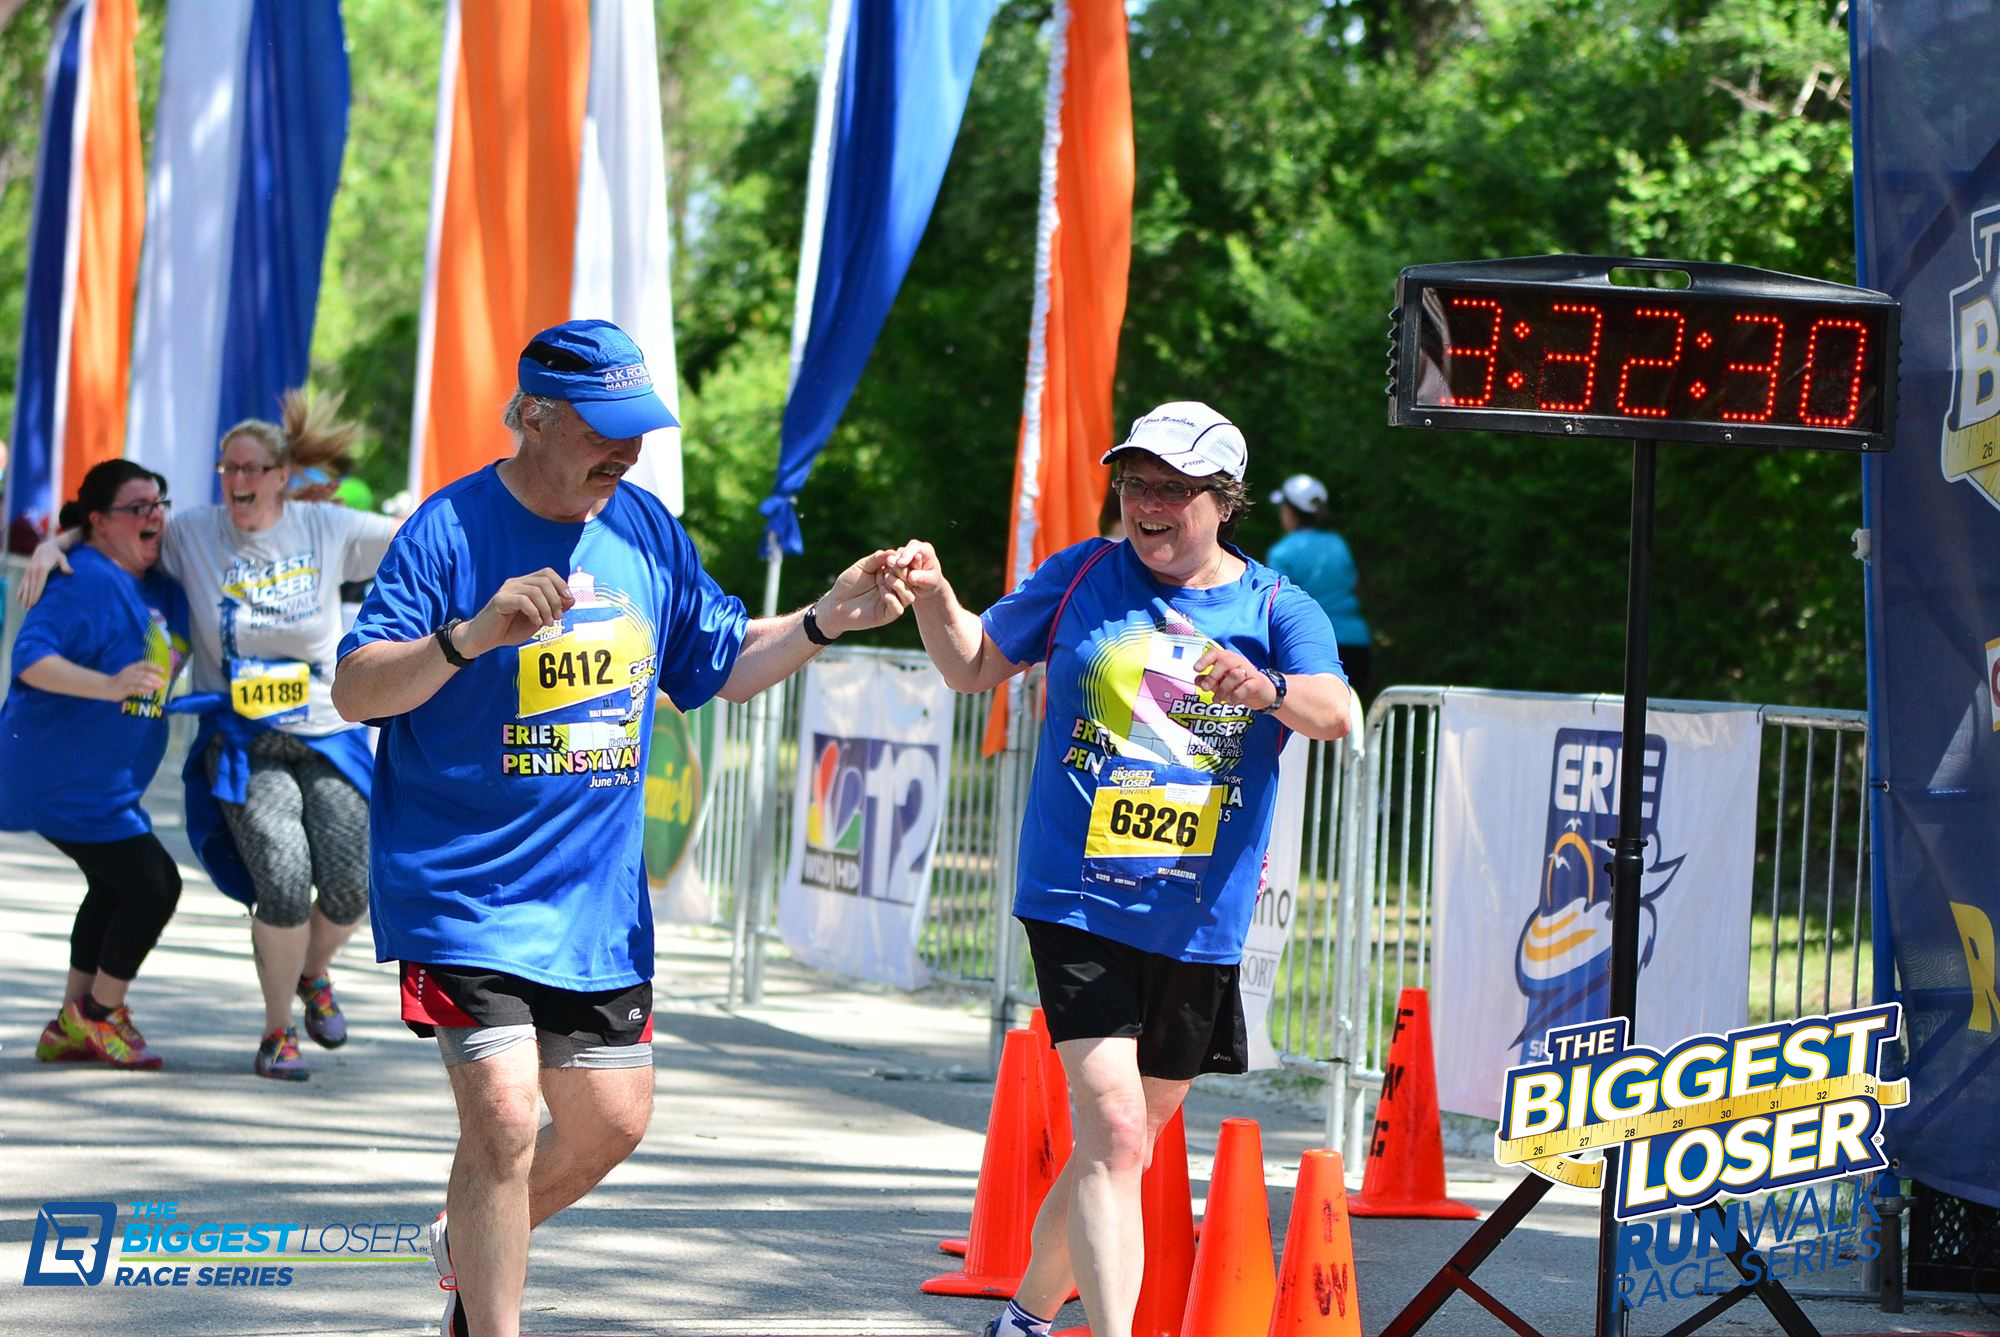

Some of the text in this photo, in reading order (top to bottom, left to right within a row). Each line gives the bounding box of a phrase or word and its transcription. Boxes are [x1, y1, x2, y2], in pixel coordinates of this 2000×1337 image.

[1440, 299, 1867, 428] 3:32:30
[1983, 441, 1993, 459] 26
[252, 572, 315, 605] LOSER
[538, 649, 614, 689] 6412
[240, 682, 303, 705] 14189
[1184, 694, 1200, 702] THE
[502, 723, 560, 750] ERIE,
[1194, 720, 1248, 737] LOSER
[589, 774, 613, 788] June
[614, 771, 632, 787] 7th,
[1121, 779, 1151, 788] LOSER
[866, 743, 938, 905] 12
[1110, 798, 1200, 848] 6326
[835, 859, 860, 889] HD
